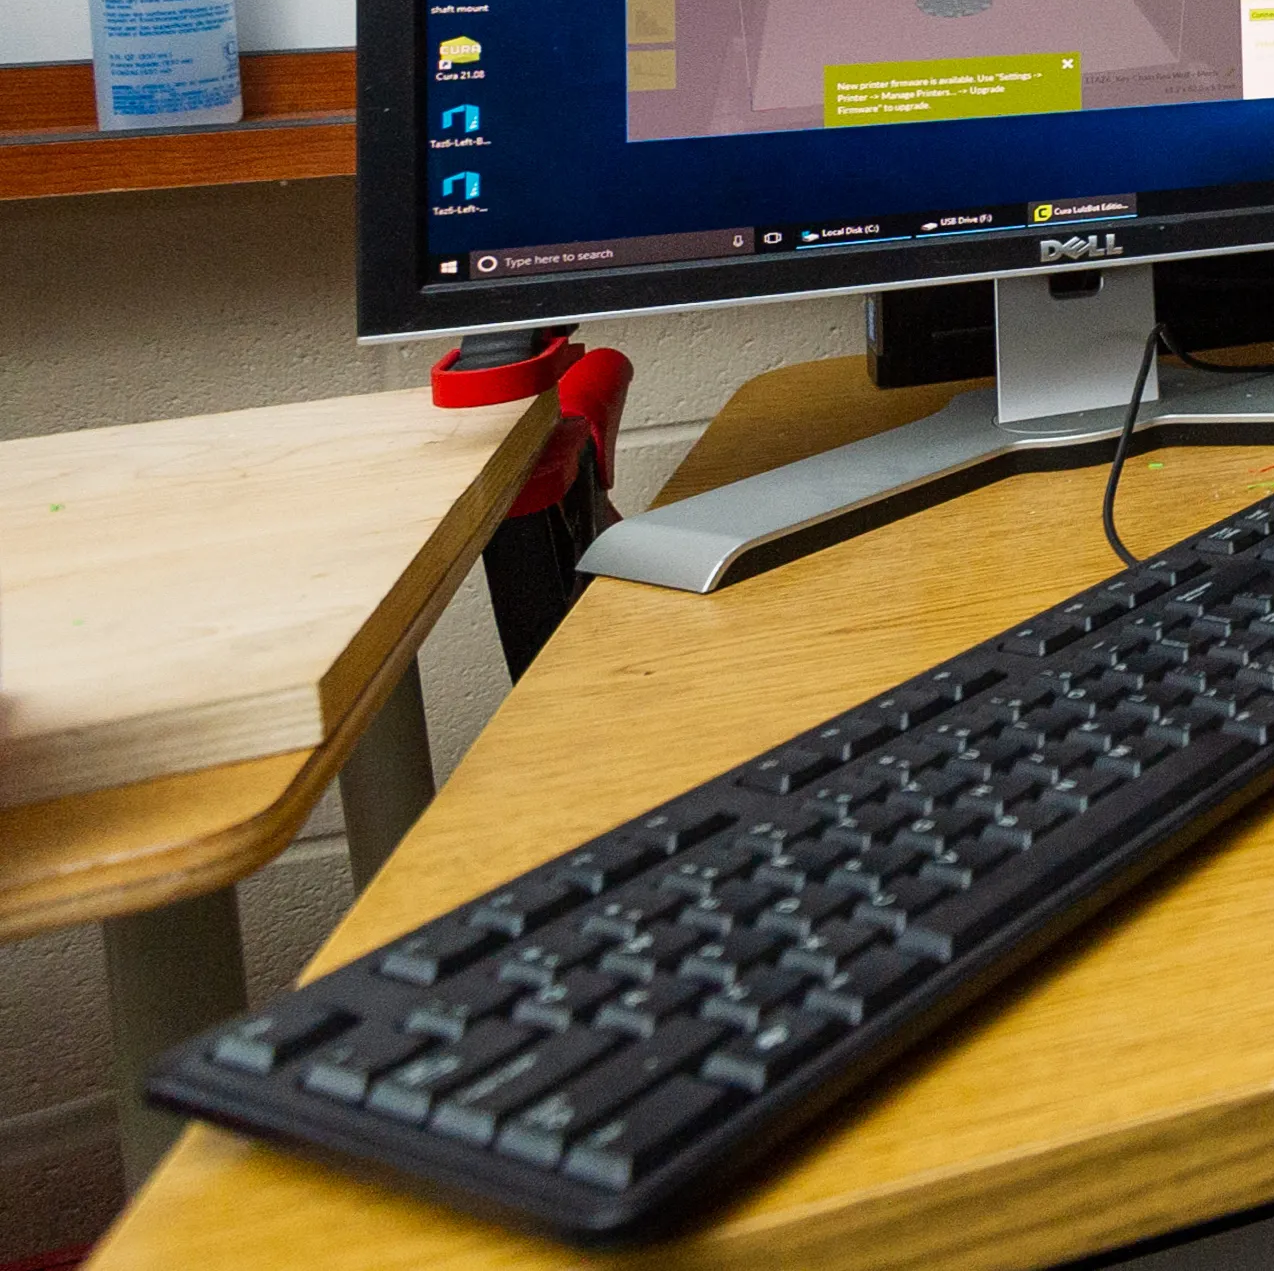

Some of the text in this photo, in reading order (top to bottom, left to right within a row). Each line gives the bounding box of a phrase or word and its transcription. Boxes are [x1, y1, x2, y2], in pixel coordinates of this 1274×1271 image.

[439, 44, 482, 55] CURA
[837, 74, 994, 91] New printer firmware Use
[837, 85, 1005, 103] Printer Manage Upgrade
[822, 228, 844, 238] Local
[845, 227, 863, 236] Disk
[957, 215, 978, 225] Drive
[1040, 233, 1124, 263] DELL
[504, 249, 614, 268] Type here to search
